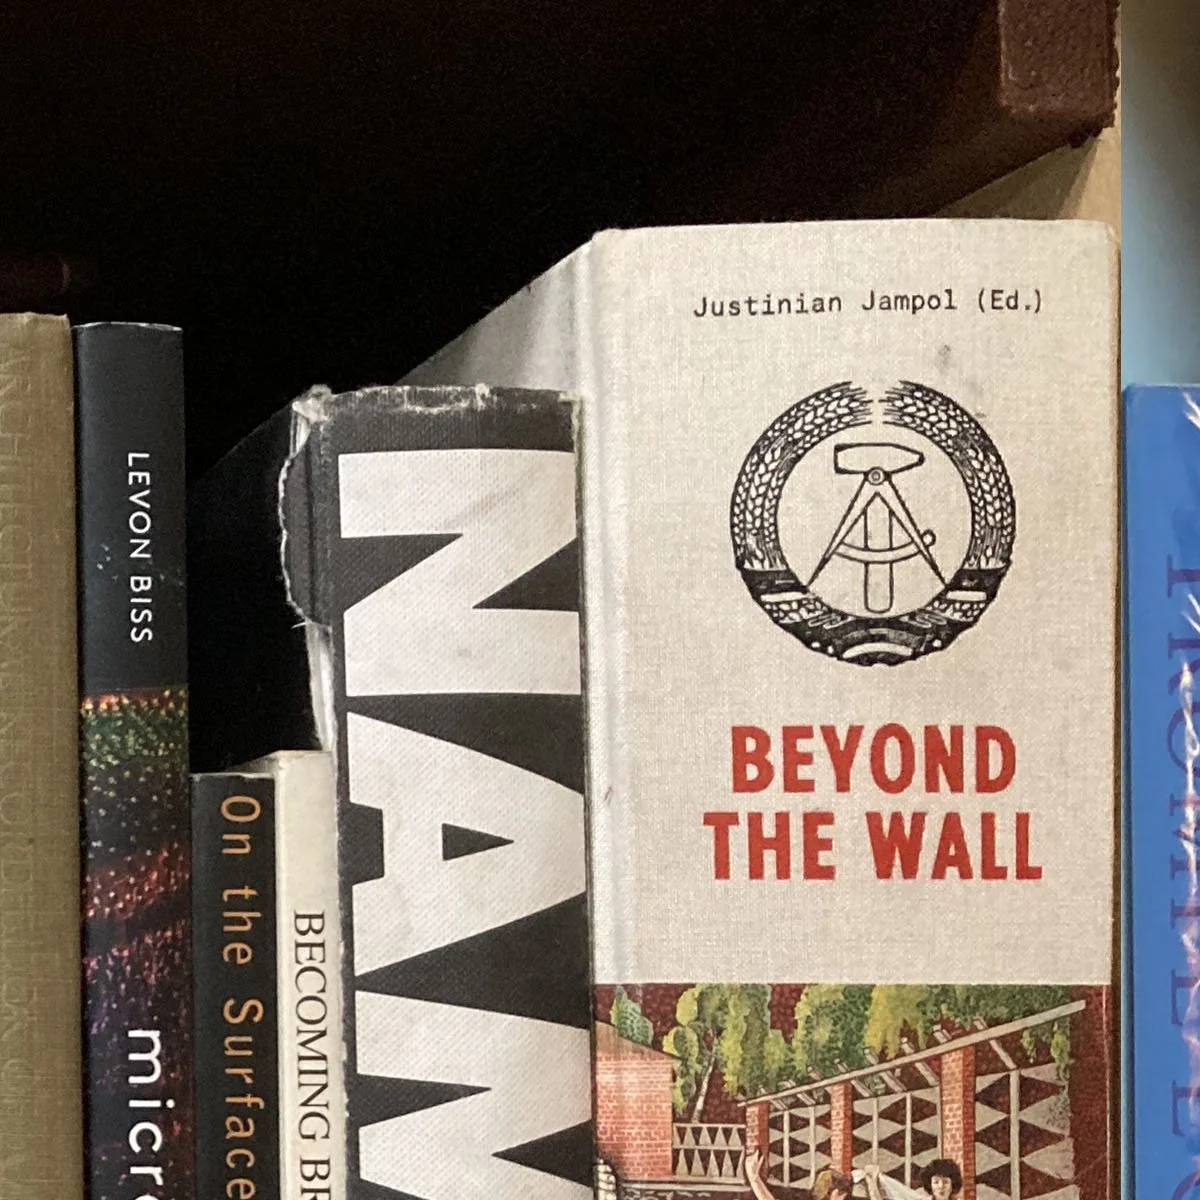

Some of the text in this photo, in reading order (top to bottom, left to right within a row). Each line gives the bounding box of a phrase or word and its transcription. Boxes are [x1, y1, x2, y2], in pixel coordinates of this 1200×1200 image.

[695, 290, 1042, 318] Justinian Jampol (Ed.)
[129, 454, 153, 643] LEVON BISS
[733, 724, 1017, 795] BEYOND
[222, 797, 261, 854] On
[704, 813, 1043, 881] THE WALL
[224, 887, 262, 965] the
[296, 913, 331, 1141] BECOMING
[225, 1000, 265, 1200] Surface
